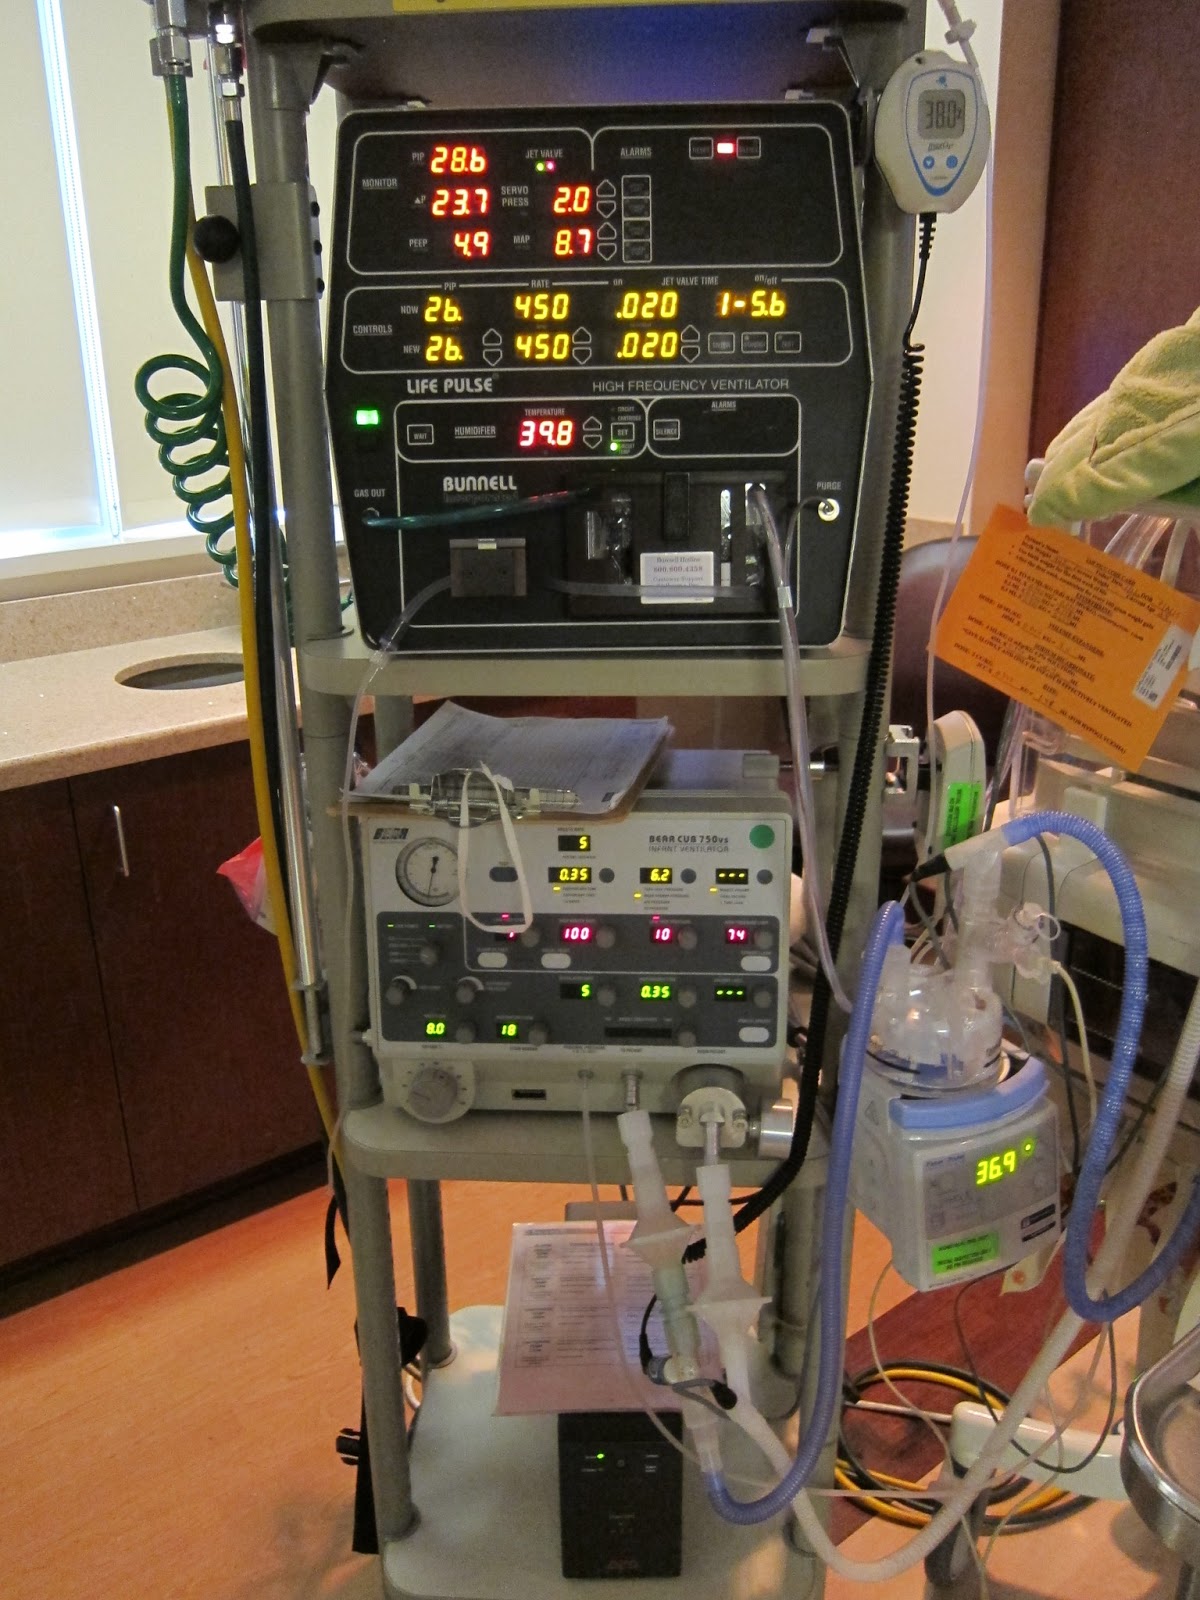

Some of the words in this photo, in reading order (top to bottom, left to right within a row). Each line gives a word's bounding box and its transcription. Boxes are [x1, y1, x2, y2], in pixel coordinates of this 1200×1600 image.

[412, 152, 425, 162] PIP
[525, 149, 540, 159] JET
[540, 149, 563, 158] VALVE
[620, 147, 652, 157] ALARMS
[430, 146, 487, 174] 28.6
[362, 178, 398, 188] MONITOR
[501, 186, 529, 195] SERVO
[431, 188, 488, 216] 23.7
[502, 198, 529, 207] PRESS
[553, 186, 590, 213] 2.0
[409, 239, 428, 248] PEEP
[455, 231, 489, 257] 4.9
[513, 235, 530, 244] MAP
[555, 228, 592, 255] 8.7
[444, 282, 456, 291] PIP
[531, 280, 550, 289] RATE
[661, 277, 674, 286] JET
[676, 277, 699, 286] VALVE
[701, 276, 719, 285] TIME
[754, 275, 778, 286] on/off
[400, 305, 418, 314] NOW
[515, 294, 569, 320] 450
[616, 291, 678, 319] .020
[353, 325, 393, 334] CONTROLS
[403, 345, 420, 354] NEW
[516, 334, 569, 359] 450
[616, 332, 678, 358] .020
[407, 378, 438, 394] LIFE
[443, 377, 493, 393] PULSE
[592, 381, 624, 391] HIGH
[628, 380, 706, 391] FREQUENCY
[710, 379, 789, 390] VENTILATOR
[525, 408, 565, 416] TEMPERATURE
[454, 427, 496, 436] HUMIDIFIER
[519, 420, 573, 447] 39.8
[443, 475, 518, 492] BUNNELL
[816, 481, 842, 491] PURGE
[354, 489, 370, 498] GAS
[371, 489, 385, 498] OUT
[579, 836, 588, 849] 5
[649, 835, 675, 843] BEAR
[677, 835, 697, 843] CUB
[698, 835, 729, 844] 750vs
[680, 845, 729, 853] VENTILATOR
[559, 868, 588, 881] 0.35
[650, 868, 670, 881] 6.2
[564, 926, 590, 941] 100
[655, 927, 671, 941] 10
[728, 928, 745, 941] 74
[581, 984, 590, 997] 5
[641, 985, 670, 998] 0.35
[426, 1022, 445, 1035] 8.0
[501, 1023, 517, 1036] 18
[976, 1150, 1016, 1185] 36.9
